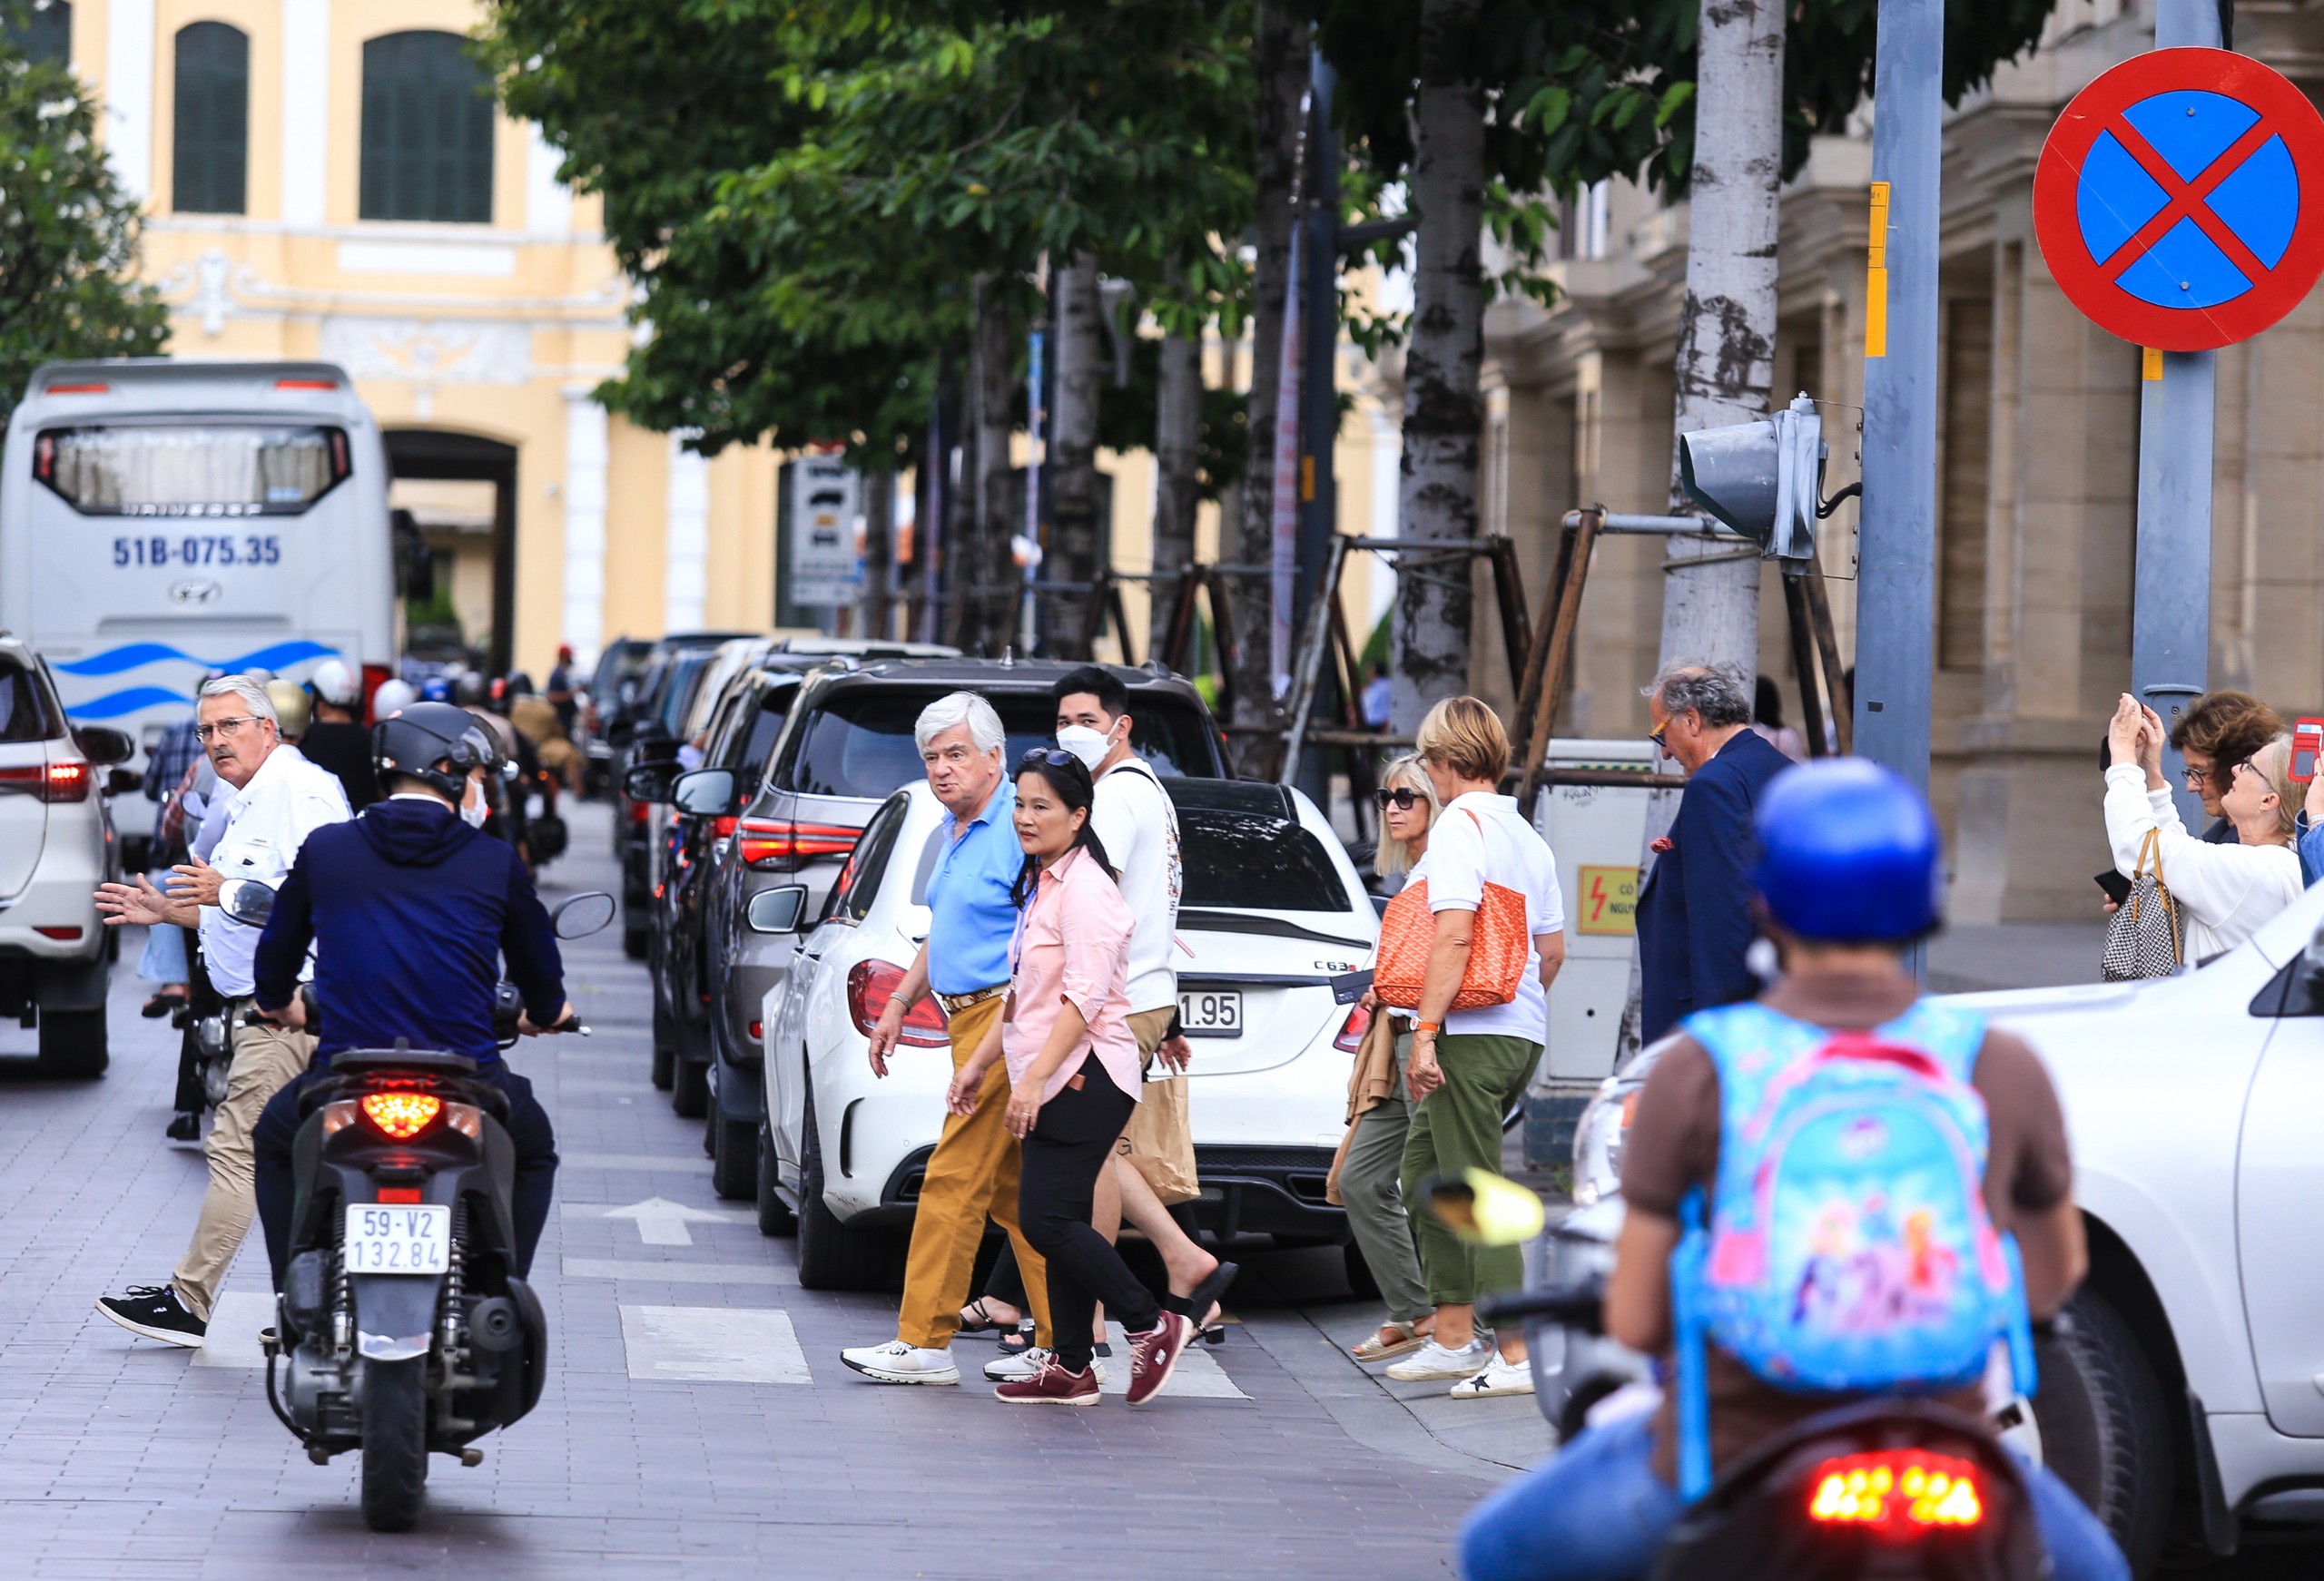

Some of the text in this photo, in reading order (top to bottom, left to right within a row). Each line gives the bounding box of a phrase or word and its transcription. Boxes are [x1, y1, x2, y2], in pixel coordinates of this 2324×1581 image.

[113, 535, 281, 566] 51B-075.35
[364, 1211, 433, 1237] 59-V2
[354, 1241, 440, 1267] 132.84
